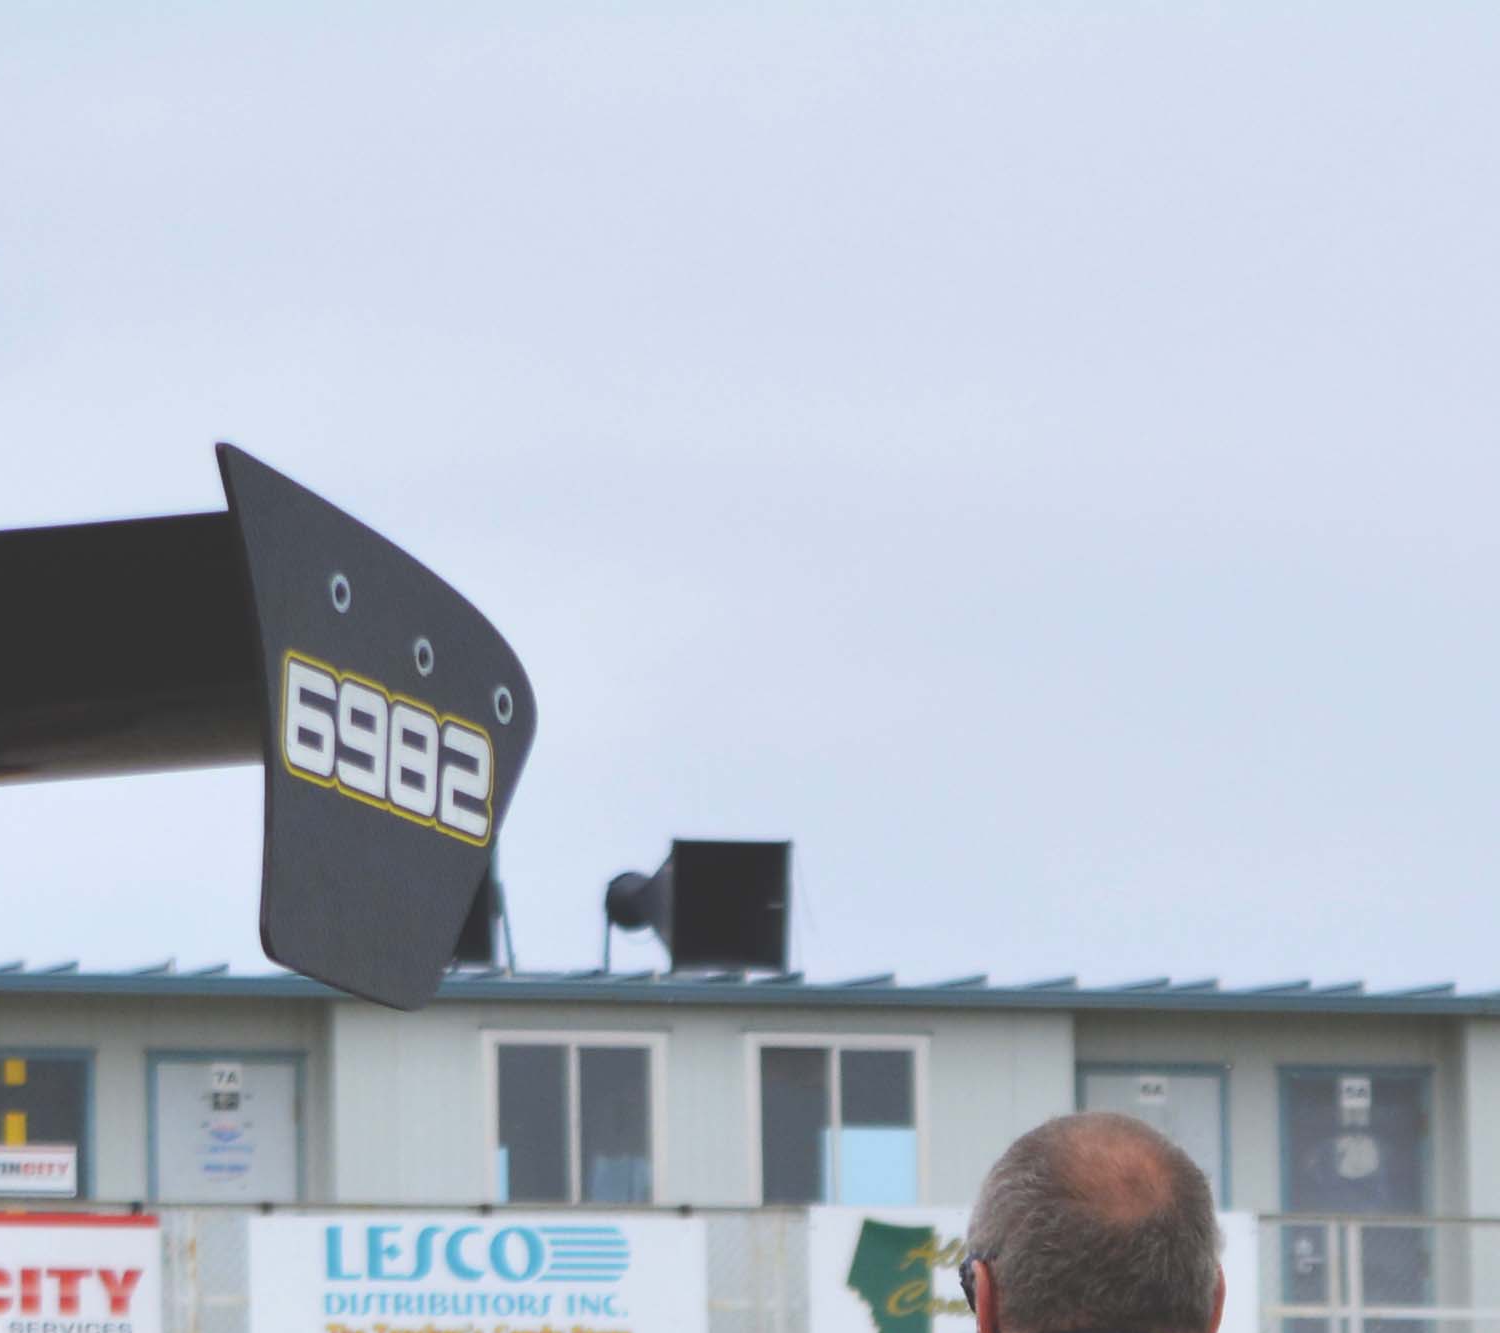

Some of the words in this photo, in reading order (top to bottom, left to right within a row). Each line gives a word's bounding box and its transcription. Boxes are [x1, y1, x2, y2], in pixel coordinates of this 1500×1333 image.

[284, 654, 491, 841] 6982
[324, 1225, 545, 1282] LESCO
[324, 1293, 550, 1317] DISTRIBUTORS
[567, 1294, 628, 1317] INC.
